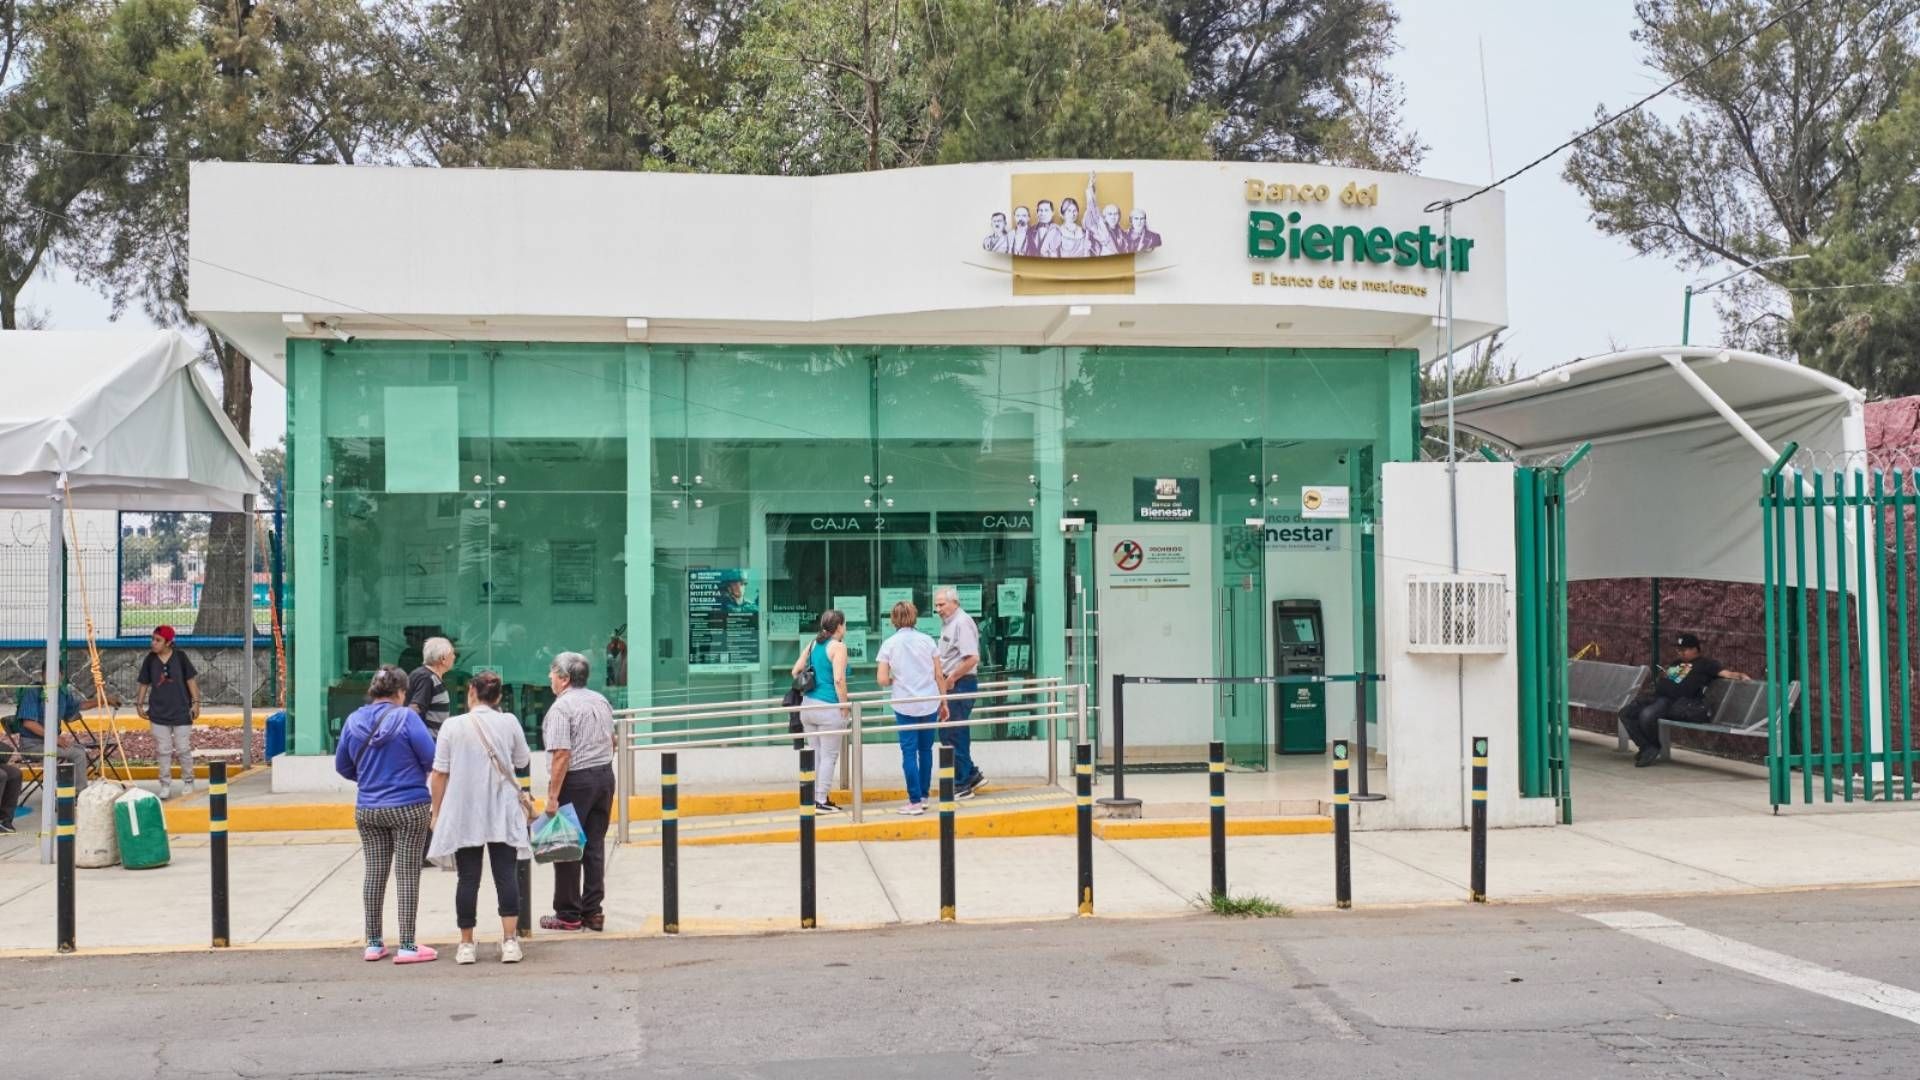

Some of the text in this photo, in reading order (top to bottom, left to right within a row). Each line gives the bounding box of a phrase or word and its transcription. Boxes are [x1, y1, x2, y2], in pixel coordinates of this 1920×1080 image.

[1246, 179, 1378, 206] Banco del
[1247, 211, 1475, 272] Bienestar
[1251, 271, 1428, 297] El banco de los mexicanos
[982, 515, 1031, 529] CAJA
[1140, 507, 1193, 517] Bienestar
[810, 517, 886, 530] CAJA 2
